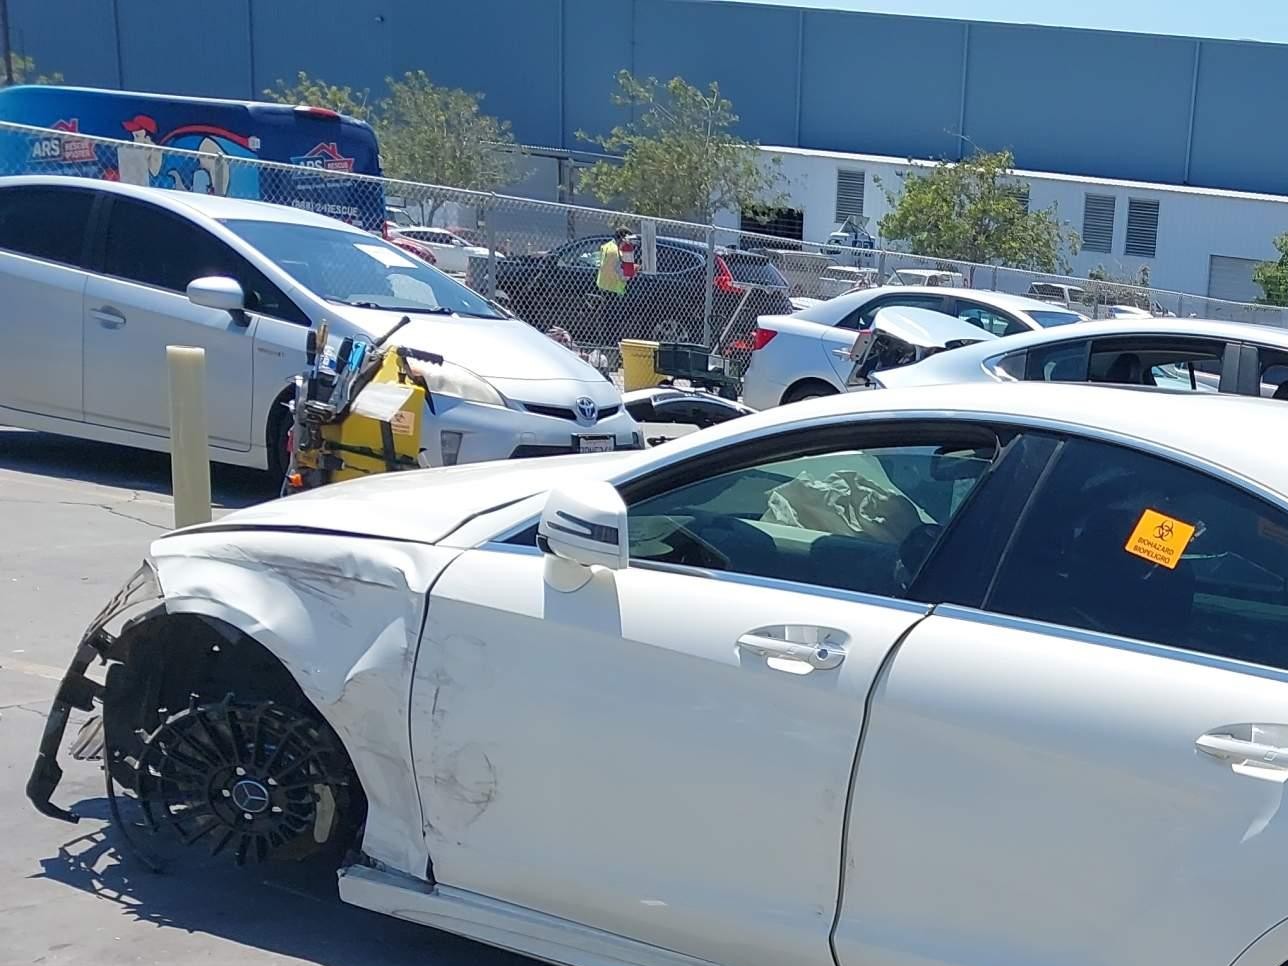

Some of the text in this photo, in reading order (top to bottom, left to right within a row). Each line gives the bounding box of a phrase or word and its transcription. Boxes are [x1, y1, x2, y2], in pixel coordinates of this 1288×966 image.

[32, 140, 61, 158] ARS
[1133, 545, 1170, 564] BIOPELIGRO
[1137, 536, 1174, 556] BIOHAZARD
